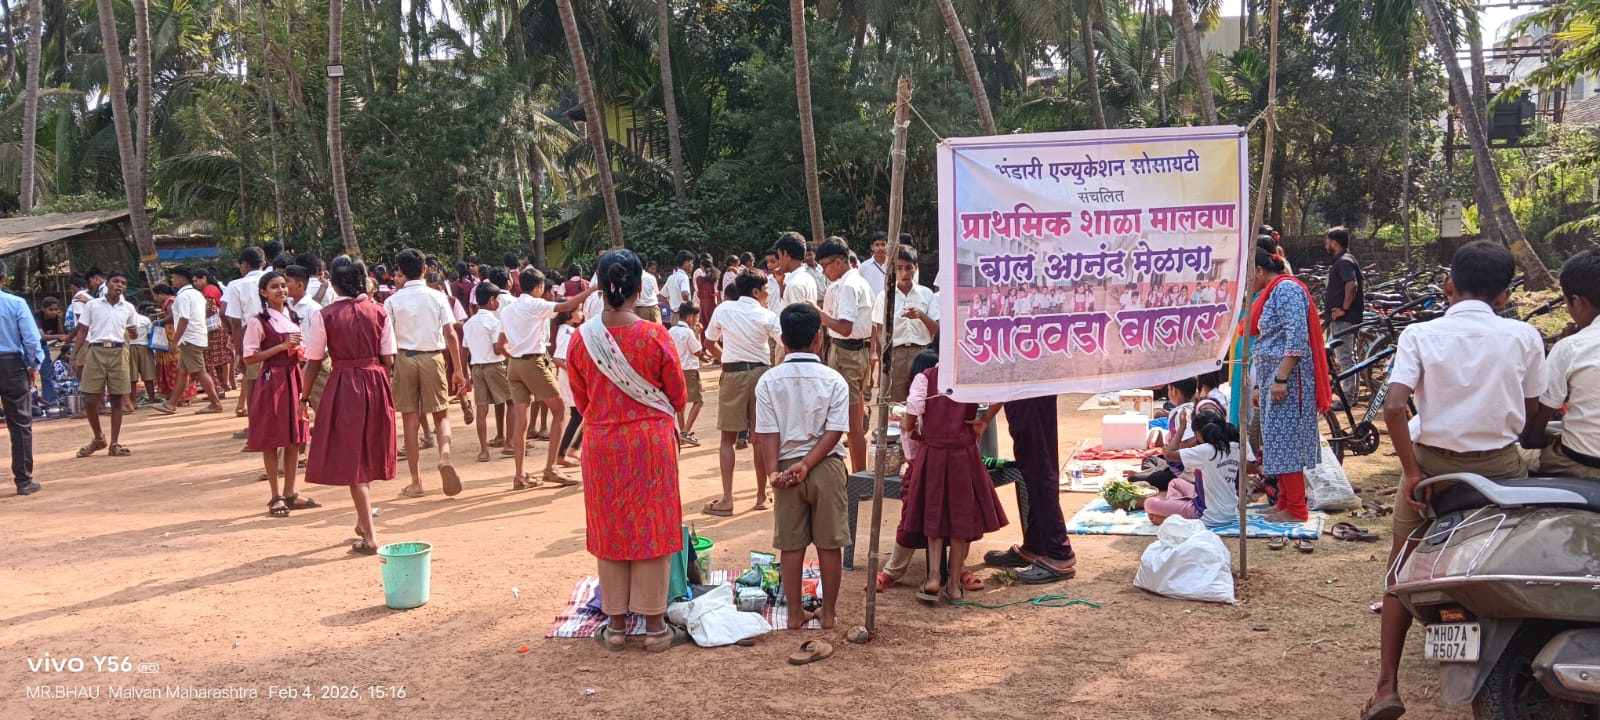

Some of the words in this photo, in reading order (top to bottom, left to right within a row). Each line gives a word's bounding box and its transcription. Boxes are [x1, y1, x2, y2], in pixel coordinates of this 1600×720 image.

[1048, 153, 1126, 185] एज्युकेशन
[1130, 148, 1200, 176] सोसायटी
[1077, 187, 1125, 204] संचलित
[960, 202, 1072, 240] प्राथमिक
[1079, 208, 1142, 238] शाळा
[1148, 203, 1236, 232] मालवण
[979, 254, 1035, 283] बाल
[1044, 243, 1126, 280] आनंद
[1133, 240, 1213, 275] मेळावा
[958, 312, 1111, 364] आठवडा
[1116, 302, 1229, 352] बाजार
[1432, 643, 1466, 659] R5074
[1433, 625, 1467, 642] MH07A
